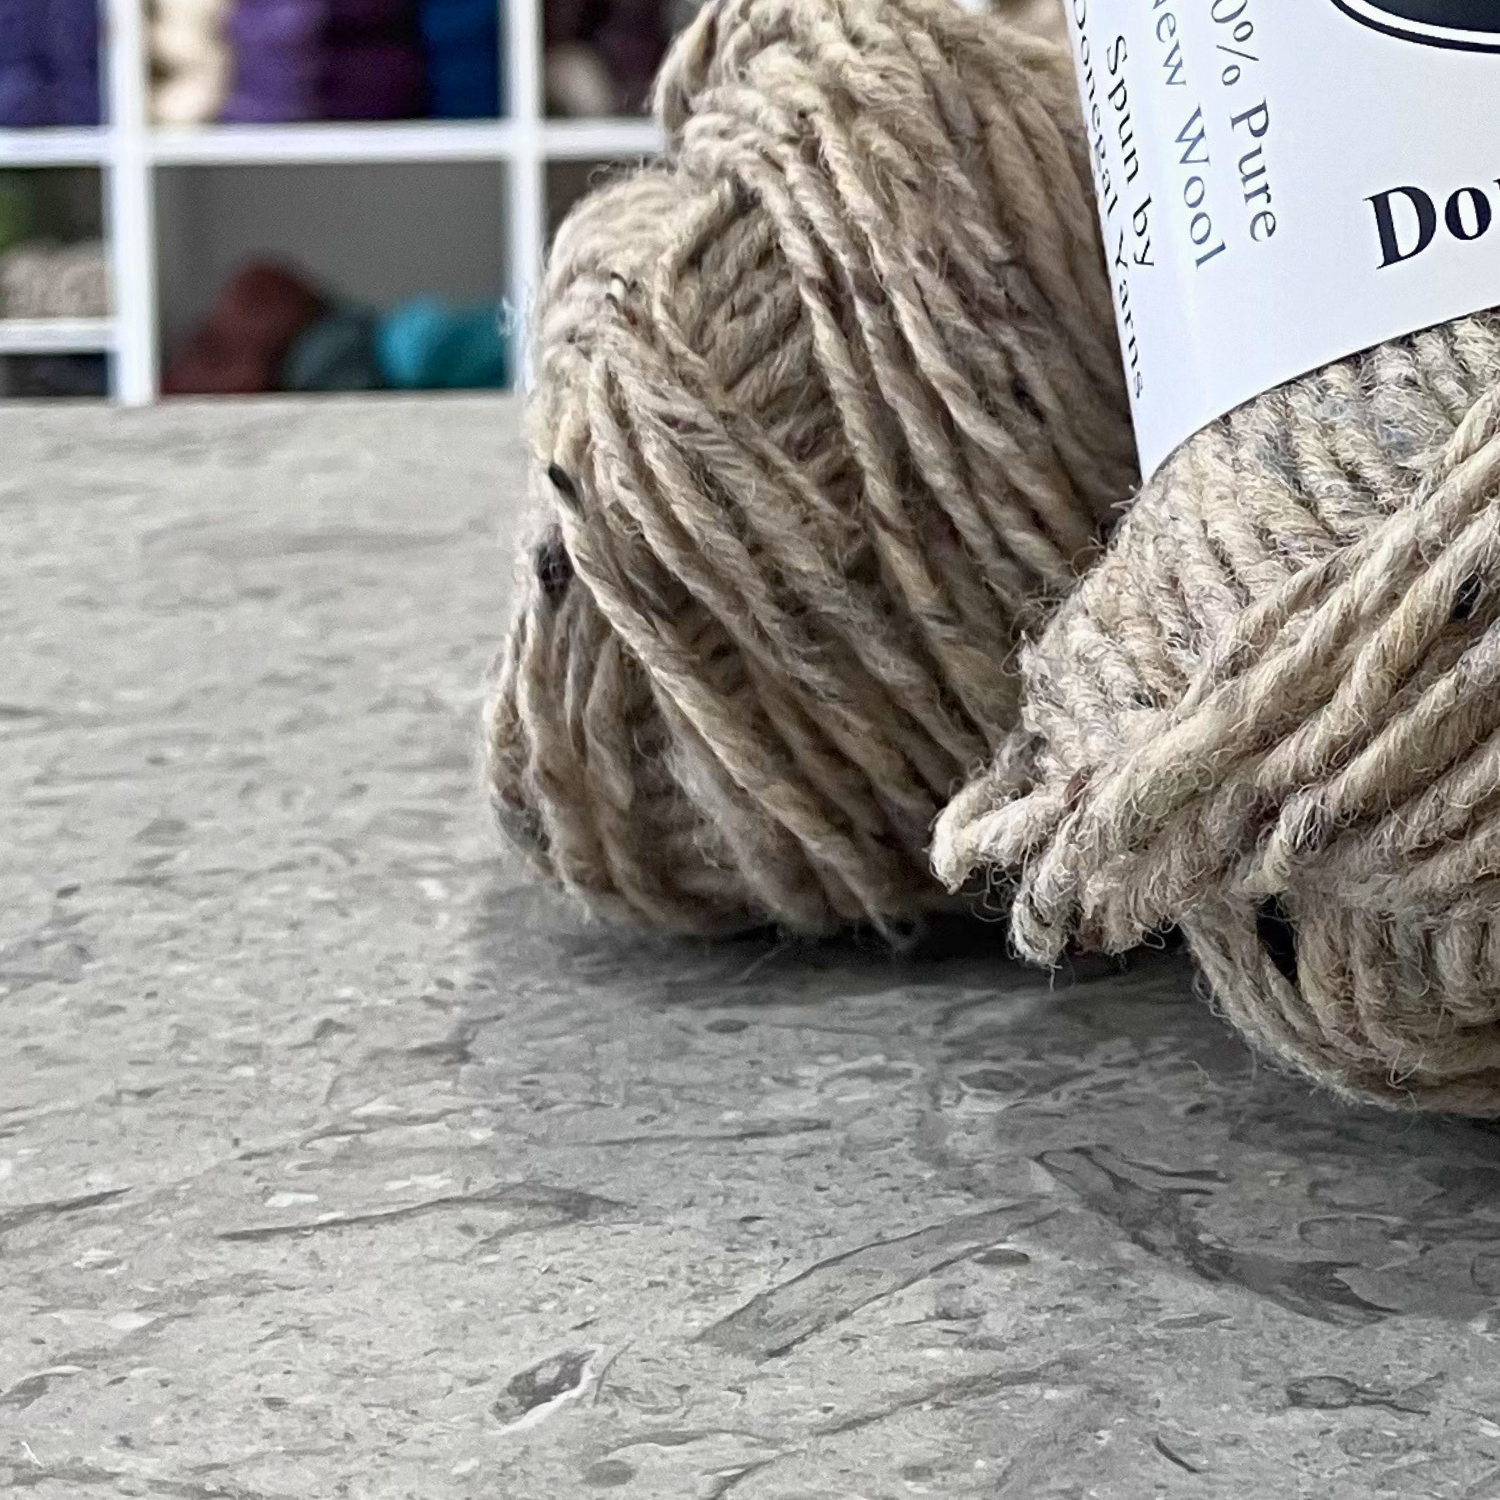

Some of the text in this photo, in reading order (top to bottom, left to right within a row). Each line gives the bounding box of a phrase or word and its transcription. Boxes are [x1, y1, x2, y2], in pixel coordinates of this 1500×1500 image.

[1106, 34, 1155, 268] Spun by
[1174, 105, 1227, 269] Wool
[1230, 96, 1277, 243] Pure
[1115, 226, 1144, 399] Yarns
